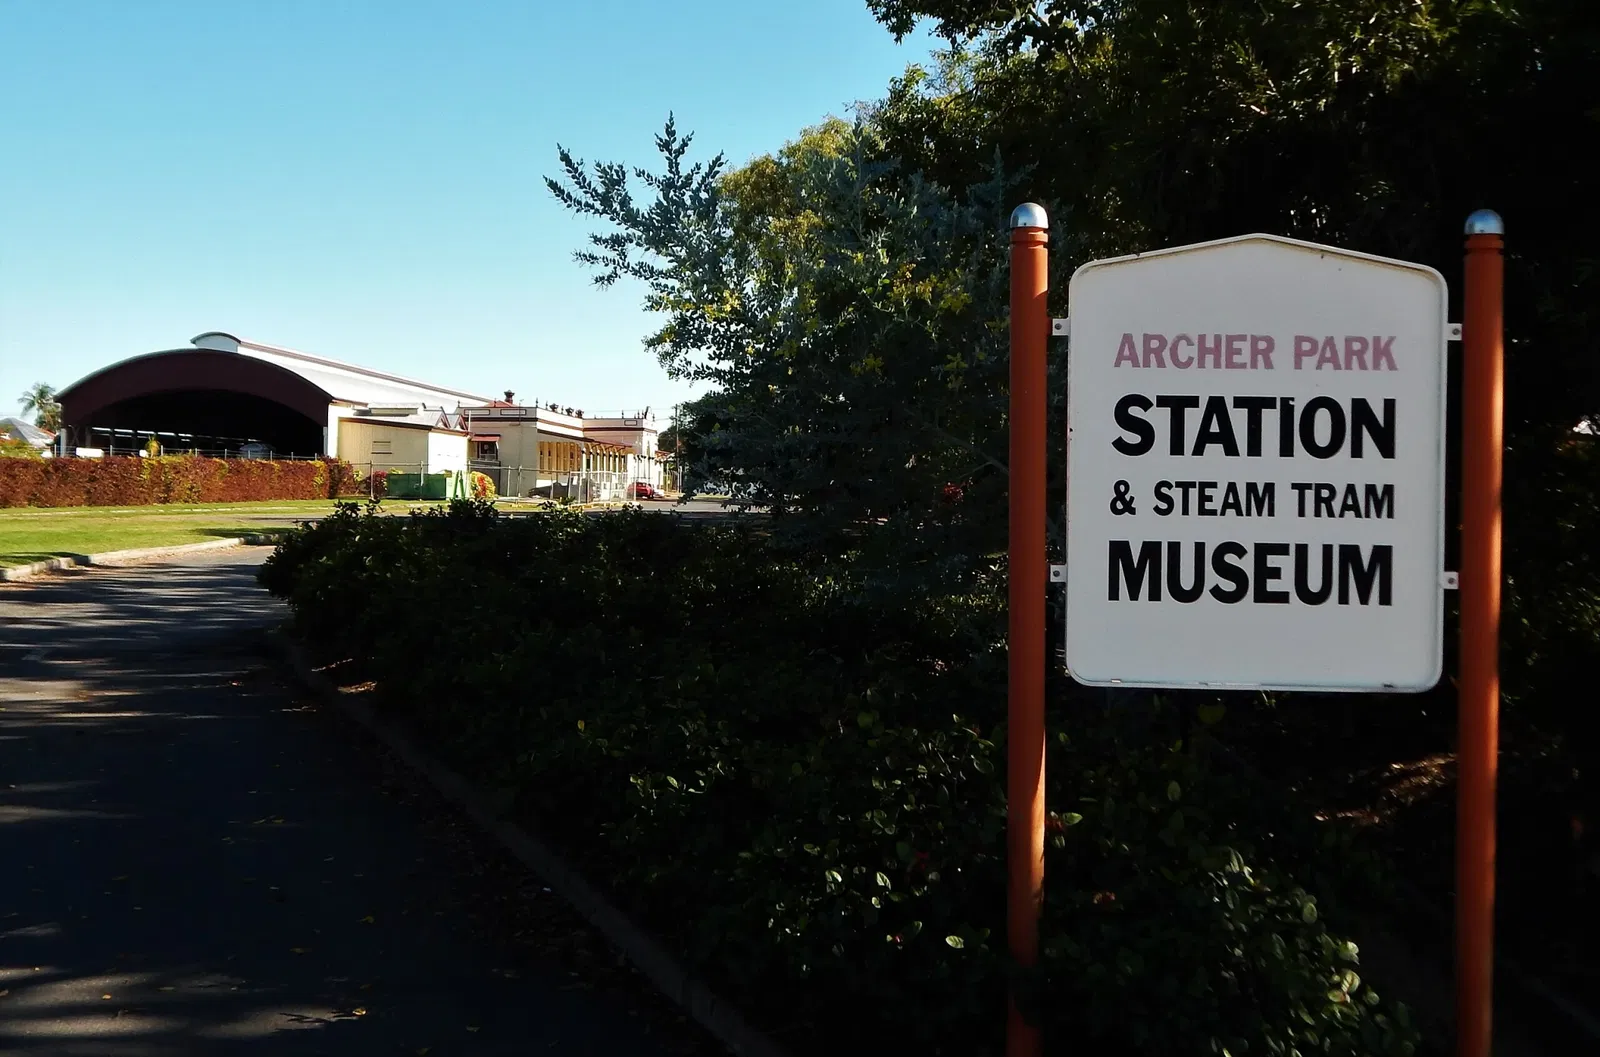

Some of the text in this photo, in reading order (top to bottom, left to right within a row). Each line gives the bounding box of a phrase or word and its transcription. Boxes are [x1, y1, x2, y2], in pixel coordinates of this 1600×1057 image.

[1113, 332, 1399, 372] ARCHER PARK
[1110, 393, 1397, 459] STATION
[1109, 479, 1396, 519] & STEAM TRAM
[1107, 540, 1394, 607] MUSEUM
